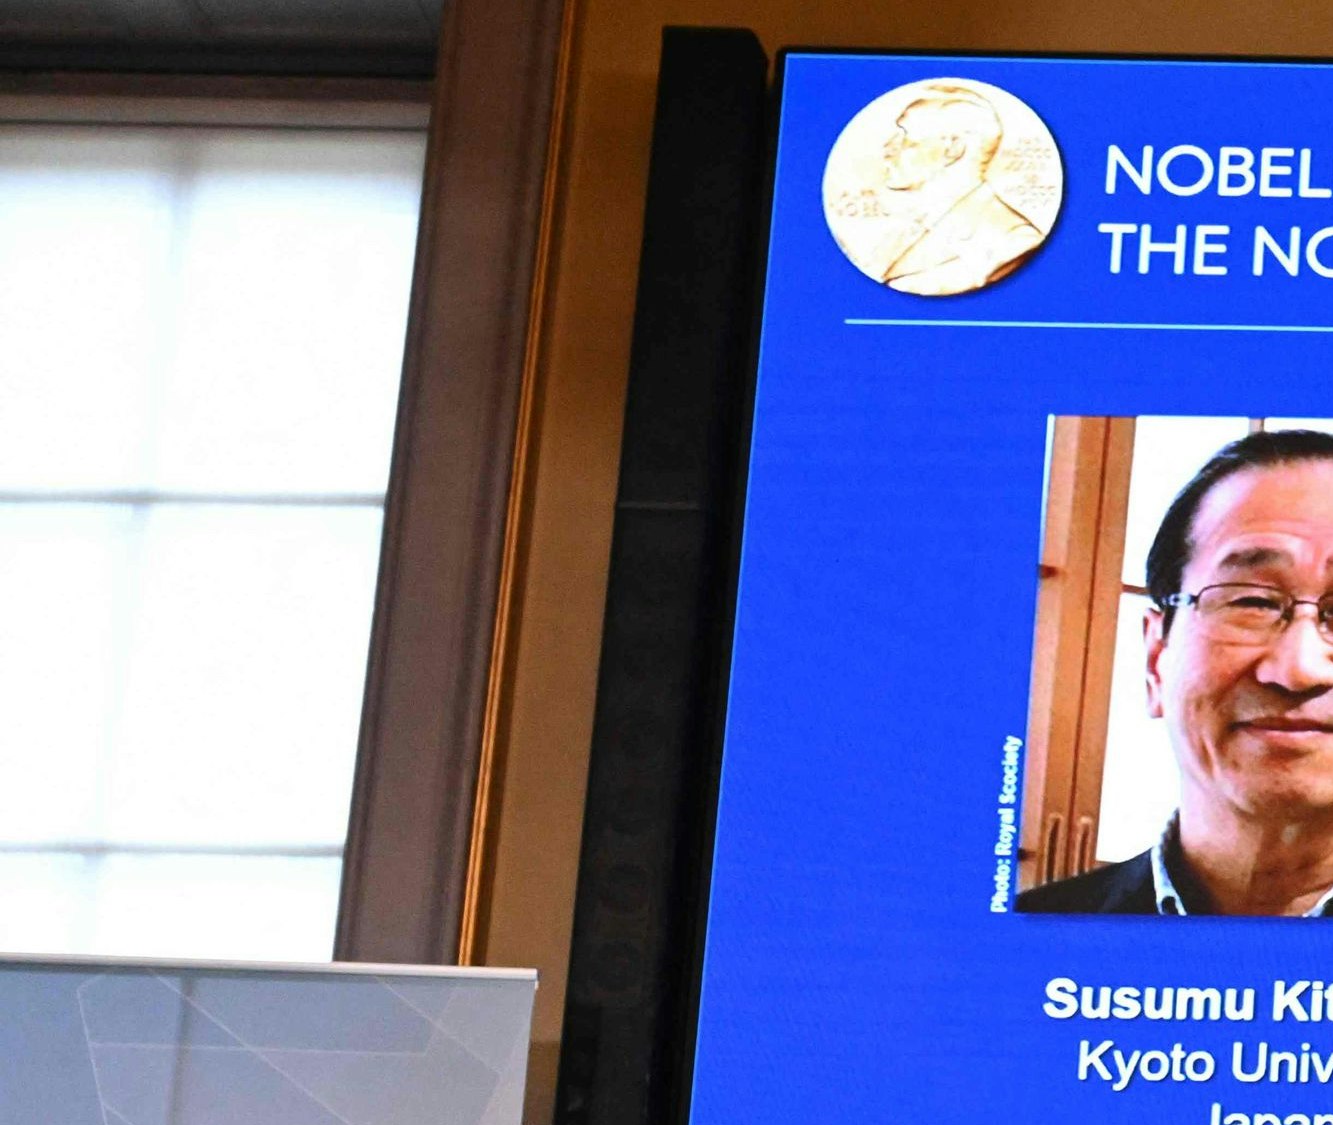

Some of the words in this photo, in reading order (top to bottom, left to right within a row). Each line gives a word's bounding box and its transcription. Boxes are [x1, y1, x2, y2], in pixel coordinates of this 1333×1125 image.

[1097, 223, 1230, 276] THE
[994, 808, 1017, 856] Royal
[989, 858, 1012, 913] Photo:
[1042, 977, 1255, 1021] Susumu
[1077, 1039, 1215, 1092] Kyoto
